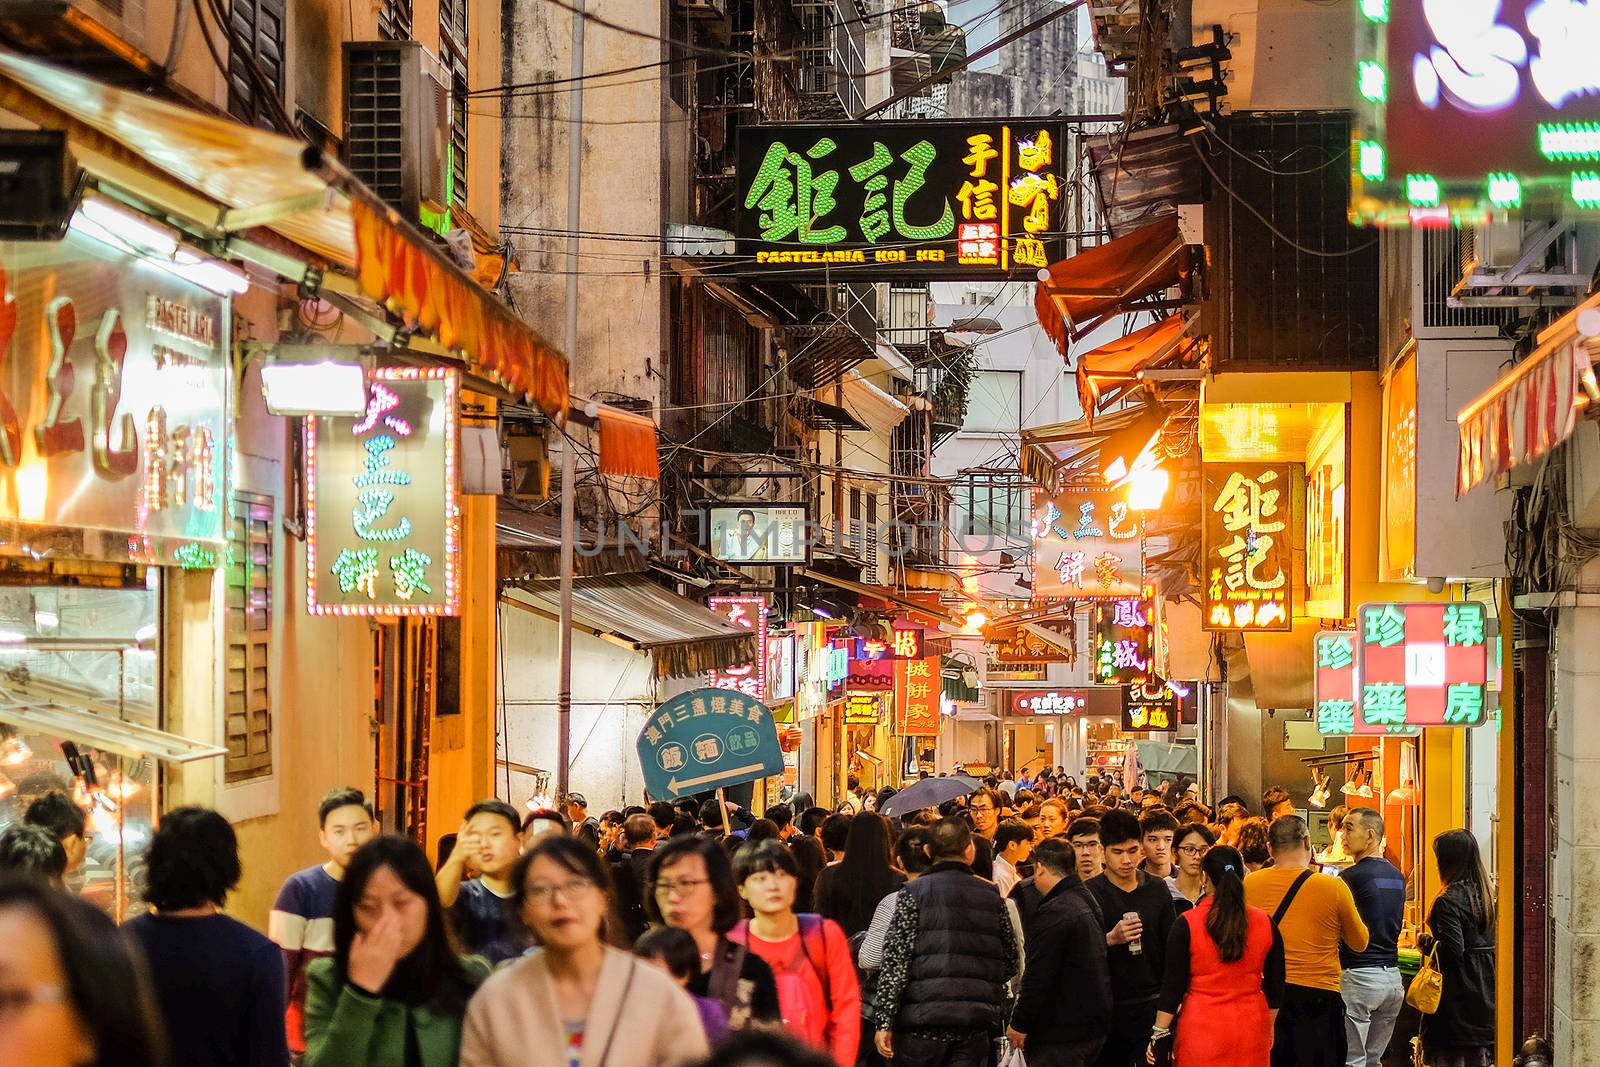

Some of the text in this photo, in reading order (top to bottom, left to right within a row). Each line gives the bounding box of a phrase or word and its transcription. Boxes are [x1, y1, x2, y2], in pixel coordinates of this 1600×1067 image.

[744, 137, 954, 244] 鉅記
[955, 133, 999, 220] 手信
[756, 250, 865, 263] PASTELARIA
[875, 250, 906, 262] KOI
[916, 249, 945, 262] KEI
[1212, 470, 1286, 592] 鉅記
[1054, 551, 1122, 590] 餅家
[1318, 635, 1353, 670] 珍
[1317, 698, 1354, 735] 藥
[1362, 682, 1484, 725] 藥房
